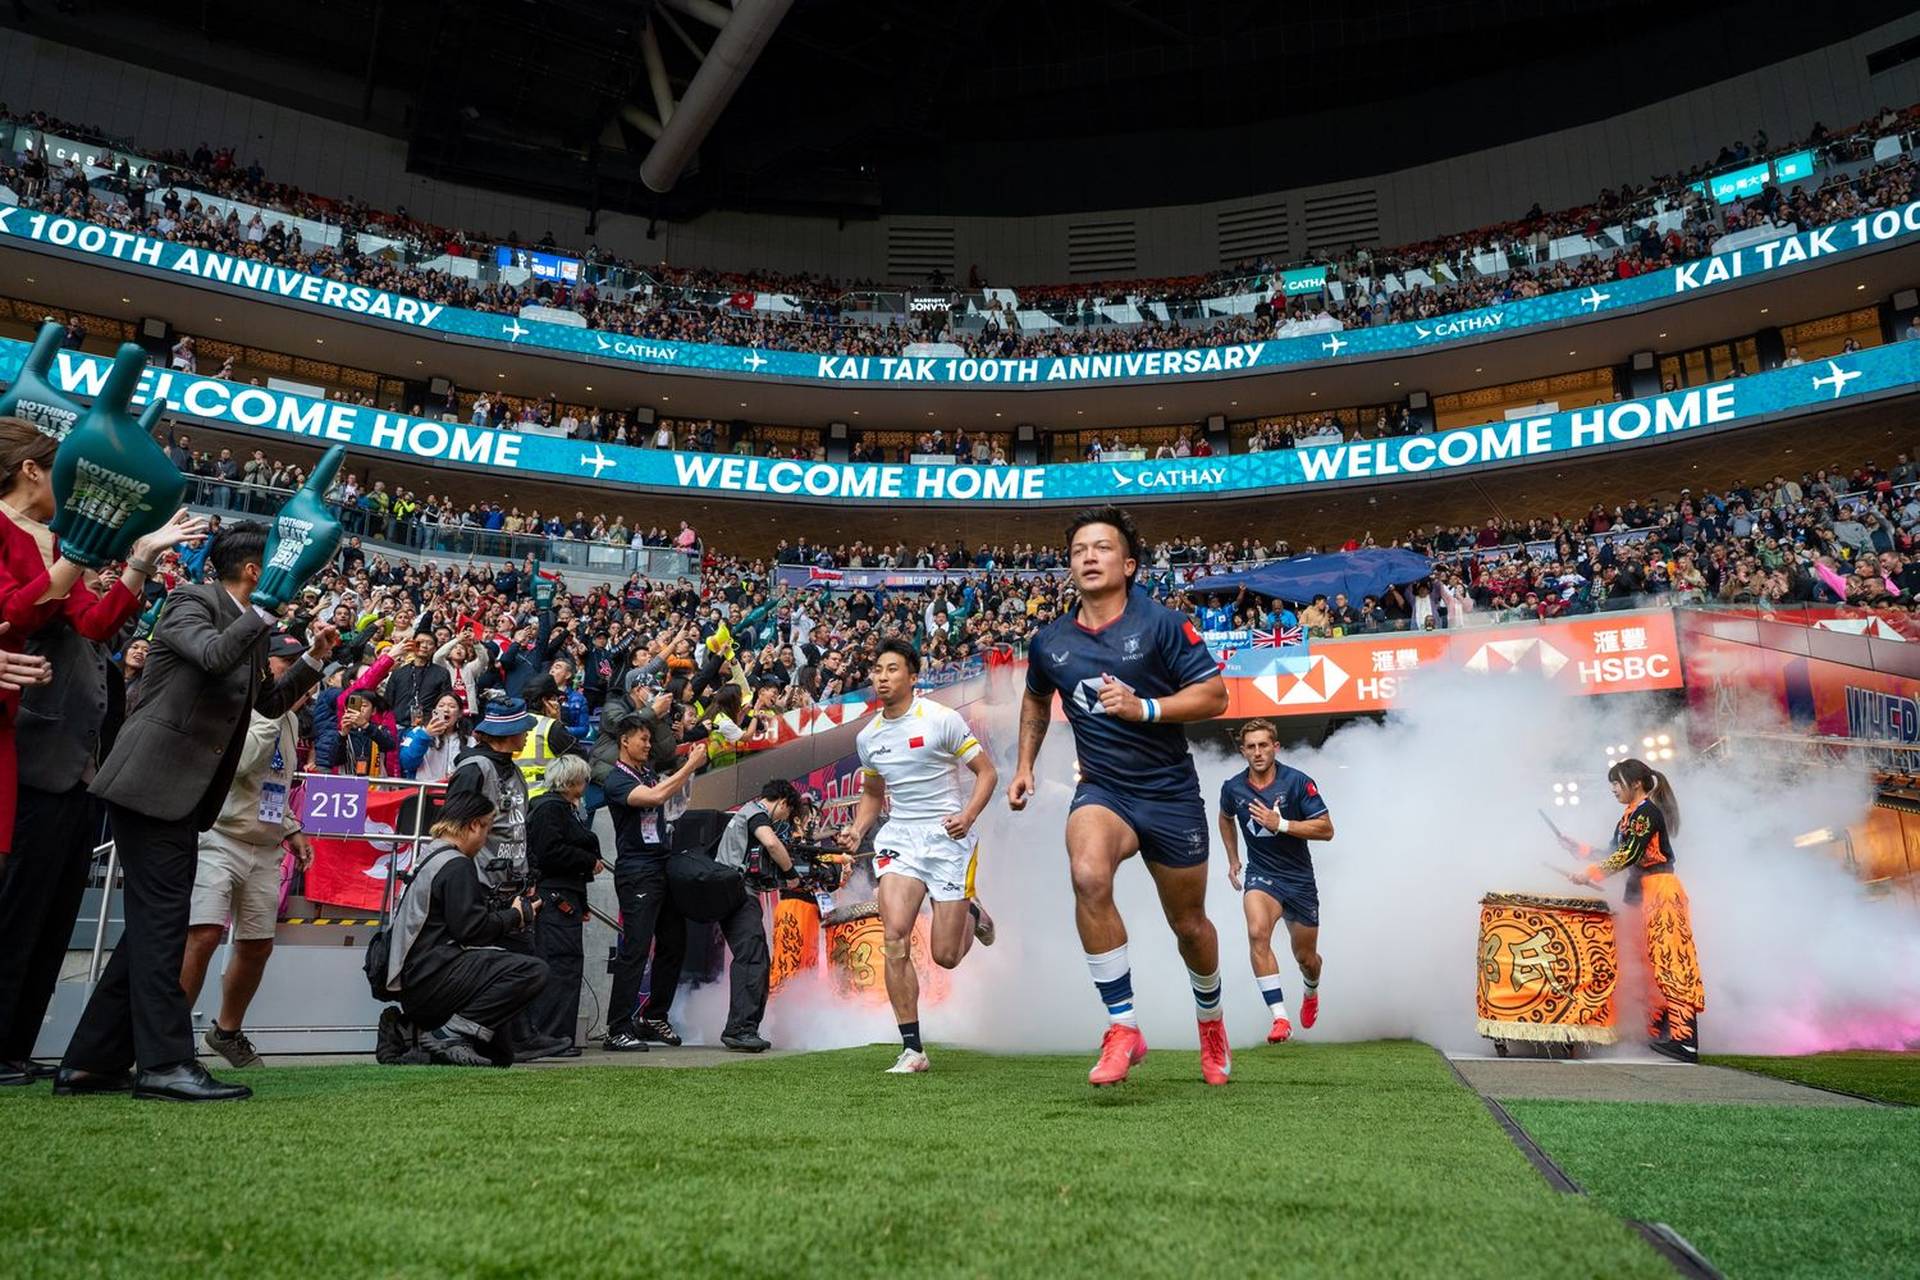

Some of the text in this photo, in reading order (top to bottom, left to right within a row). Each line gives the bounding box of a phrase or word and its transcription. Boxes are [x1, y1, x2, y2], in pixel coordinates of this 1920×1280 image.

[30, 214, 163, 266] 100TH
[173, 247, 444, 327] ANNIVERSARY
[1676, 252, 1742, 292] KAI
[1755, 226, 1838, 270] TAK
[1289, 278, 1327, 290] CATHA
[1435, 312, 1505, 337] CATHAY
[614, 341, 678, 360] CATHAY
[818, 343, 1266, 382] KAI TAK 100TH ANNIVERSARY
[16, 399, 78, 421] NOTHING
[57, 353, 525, 468] WELCOME HOME
[1297, 384, 1736, 482] WELCOME HOME
[76, 457, 151, 494] NOTHING
[674, 455, 1046, 499] WELCOME HOME
[1137, 467, 1227, 487] CATHAY
[279, 515, 314, 531] NOTHING
[1578, 654, 1670, 683] HSBC
[1357, 676, 1403, 701] HS
[1844, 685, 1920, 742] WHER
[310, 791, 360, 819] 213
